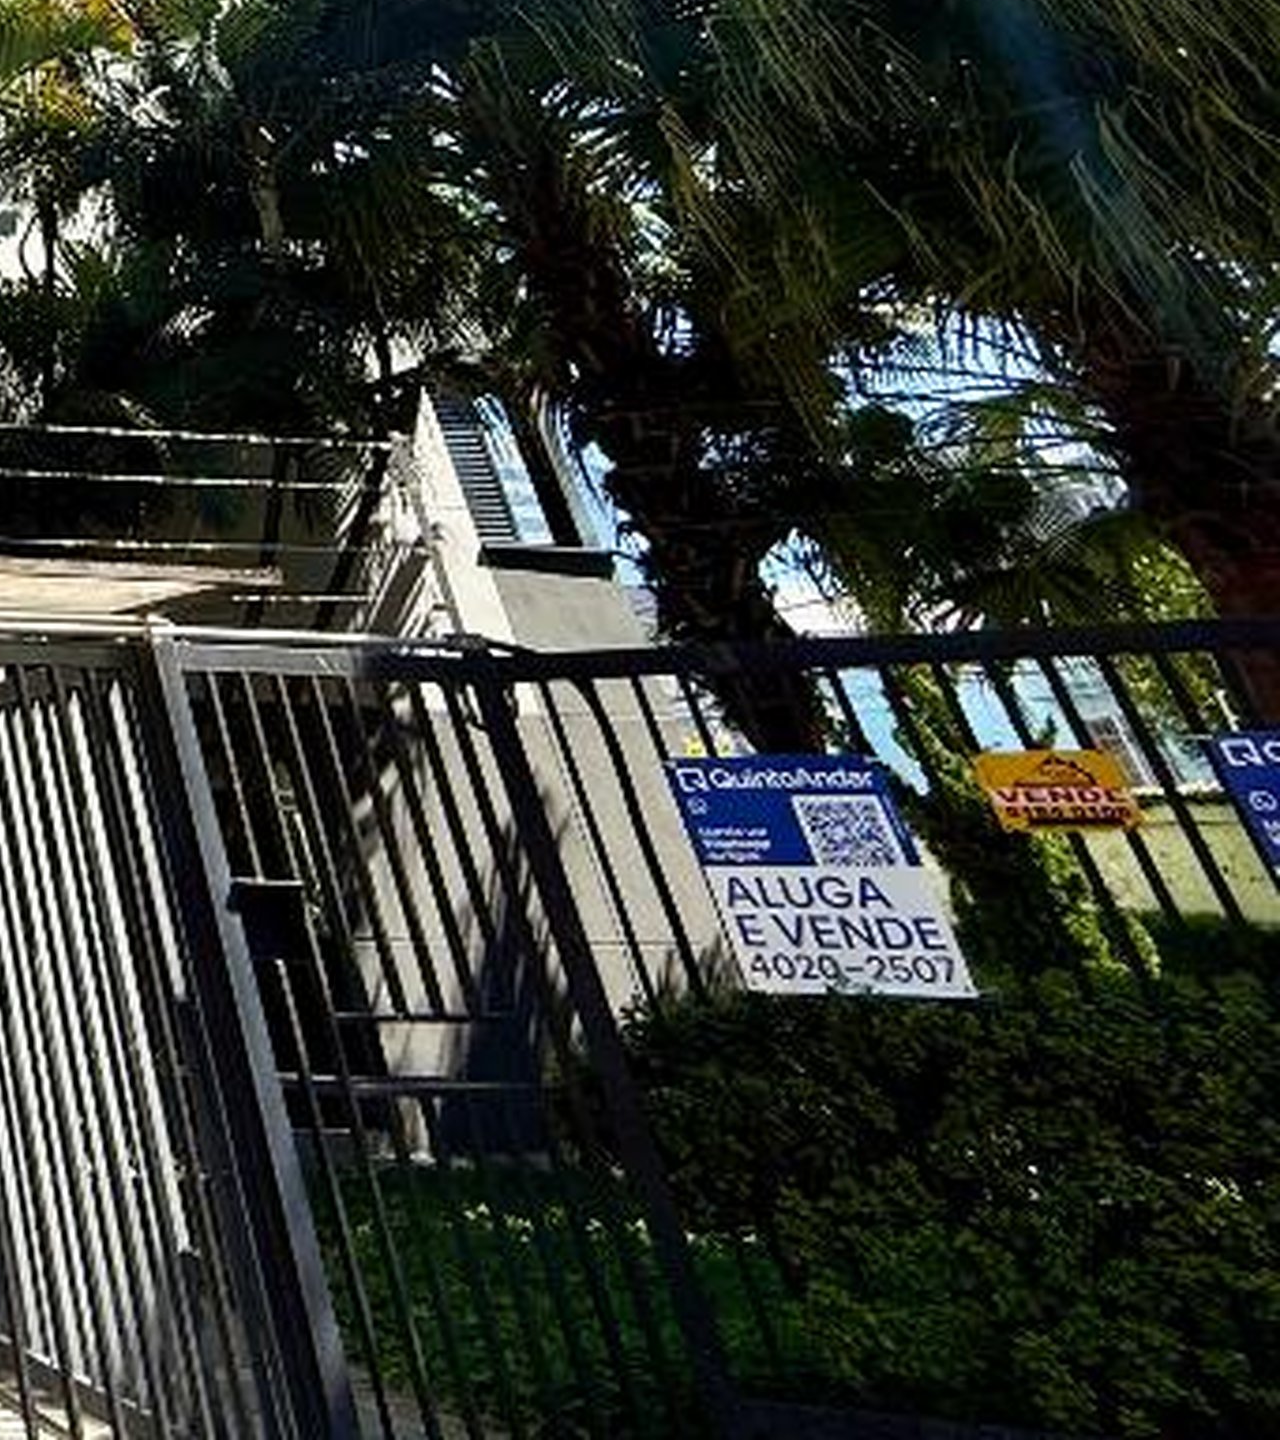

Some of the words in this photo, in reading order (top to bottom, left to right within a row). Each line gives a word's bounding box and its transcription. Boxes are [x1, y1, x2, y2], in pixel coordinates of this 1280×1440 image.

[709, 767, 874, 789] QuintoAndar
[727, 876, 893, 909] ALUGA
[736, 914, 767, 947] E
[771, 914, 948, 951] VENDE
[750, 953, 955, 984] 4020-2507
